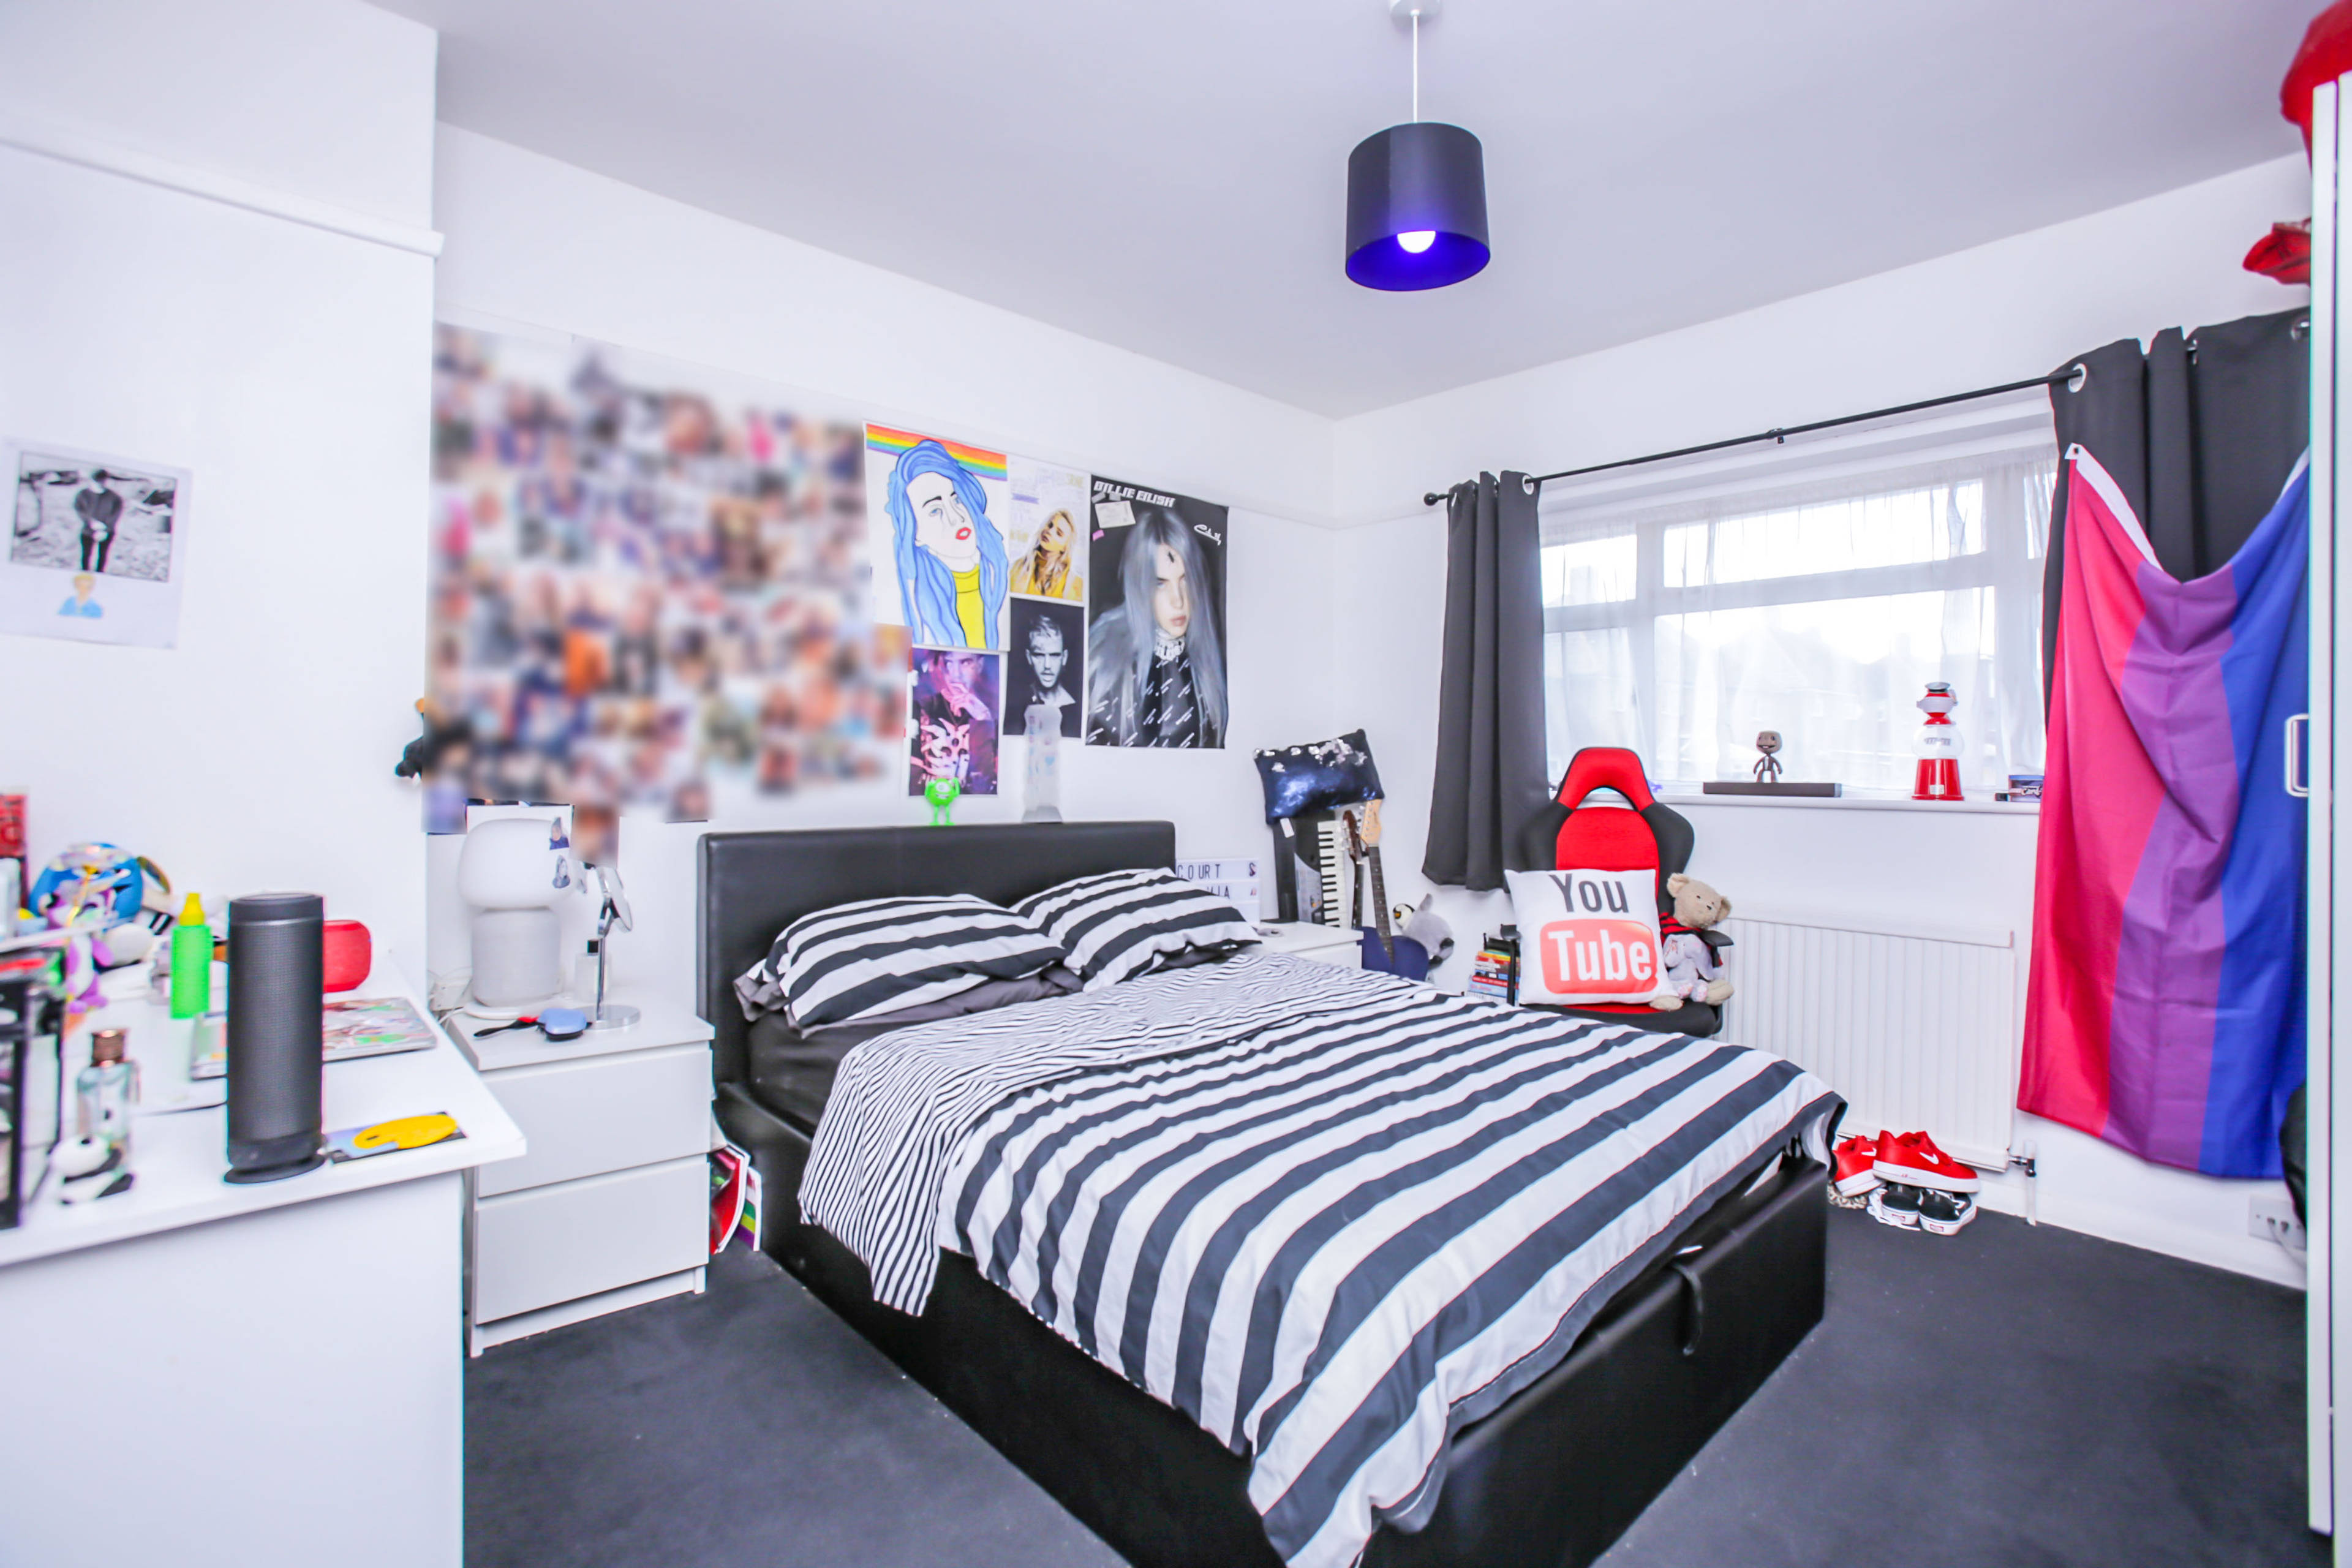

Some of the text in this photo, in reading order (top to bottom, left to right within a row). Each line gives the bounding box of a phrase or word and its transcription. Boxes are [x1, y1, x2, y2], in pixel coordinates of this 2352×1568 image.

[1093, 480, 1136, 499] BILLIE
[1136, 490, 1176, 508] EILISH
[1177, 864, 1221, 880] COURT
[1548, 873, 1629, 913] You
[1548, 929, 1653, 981] Tube
